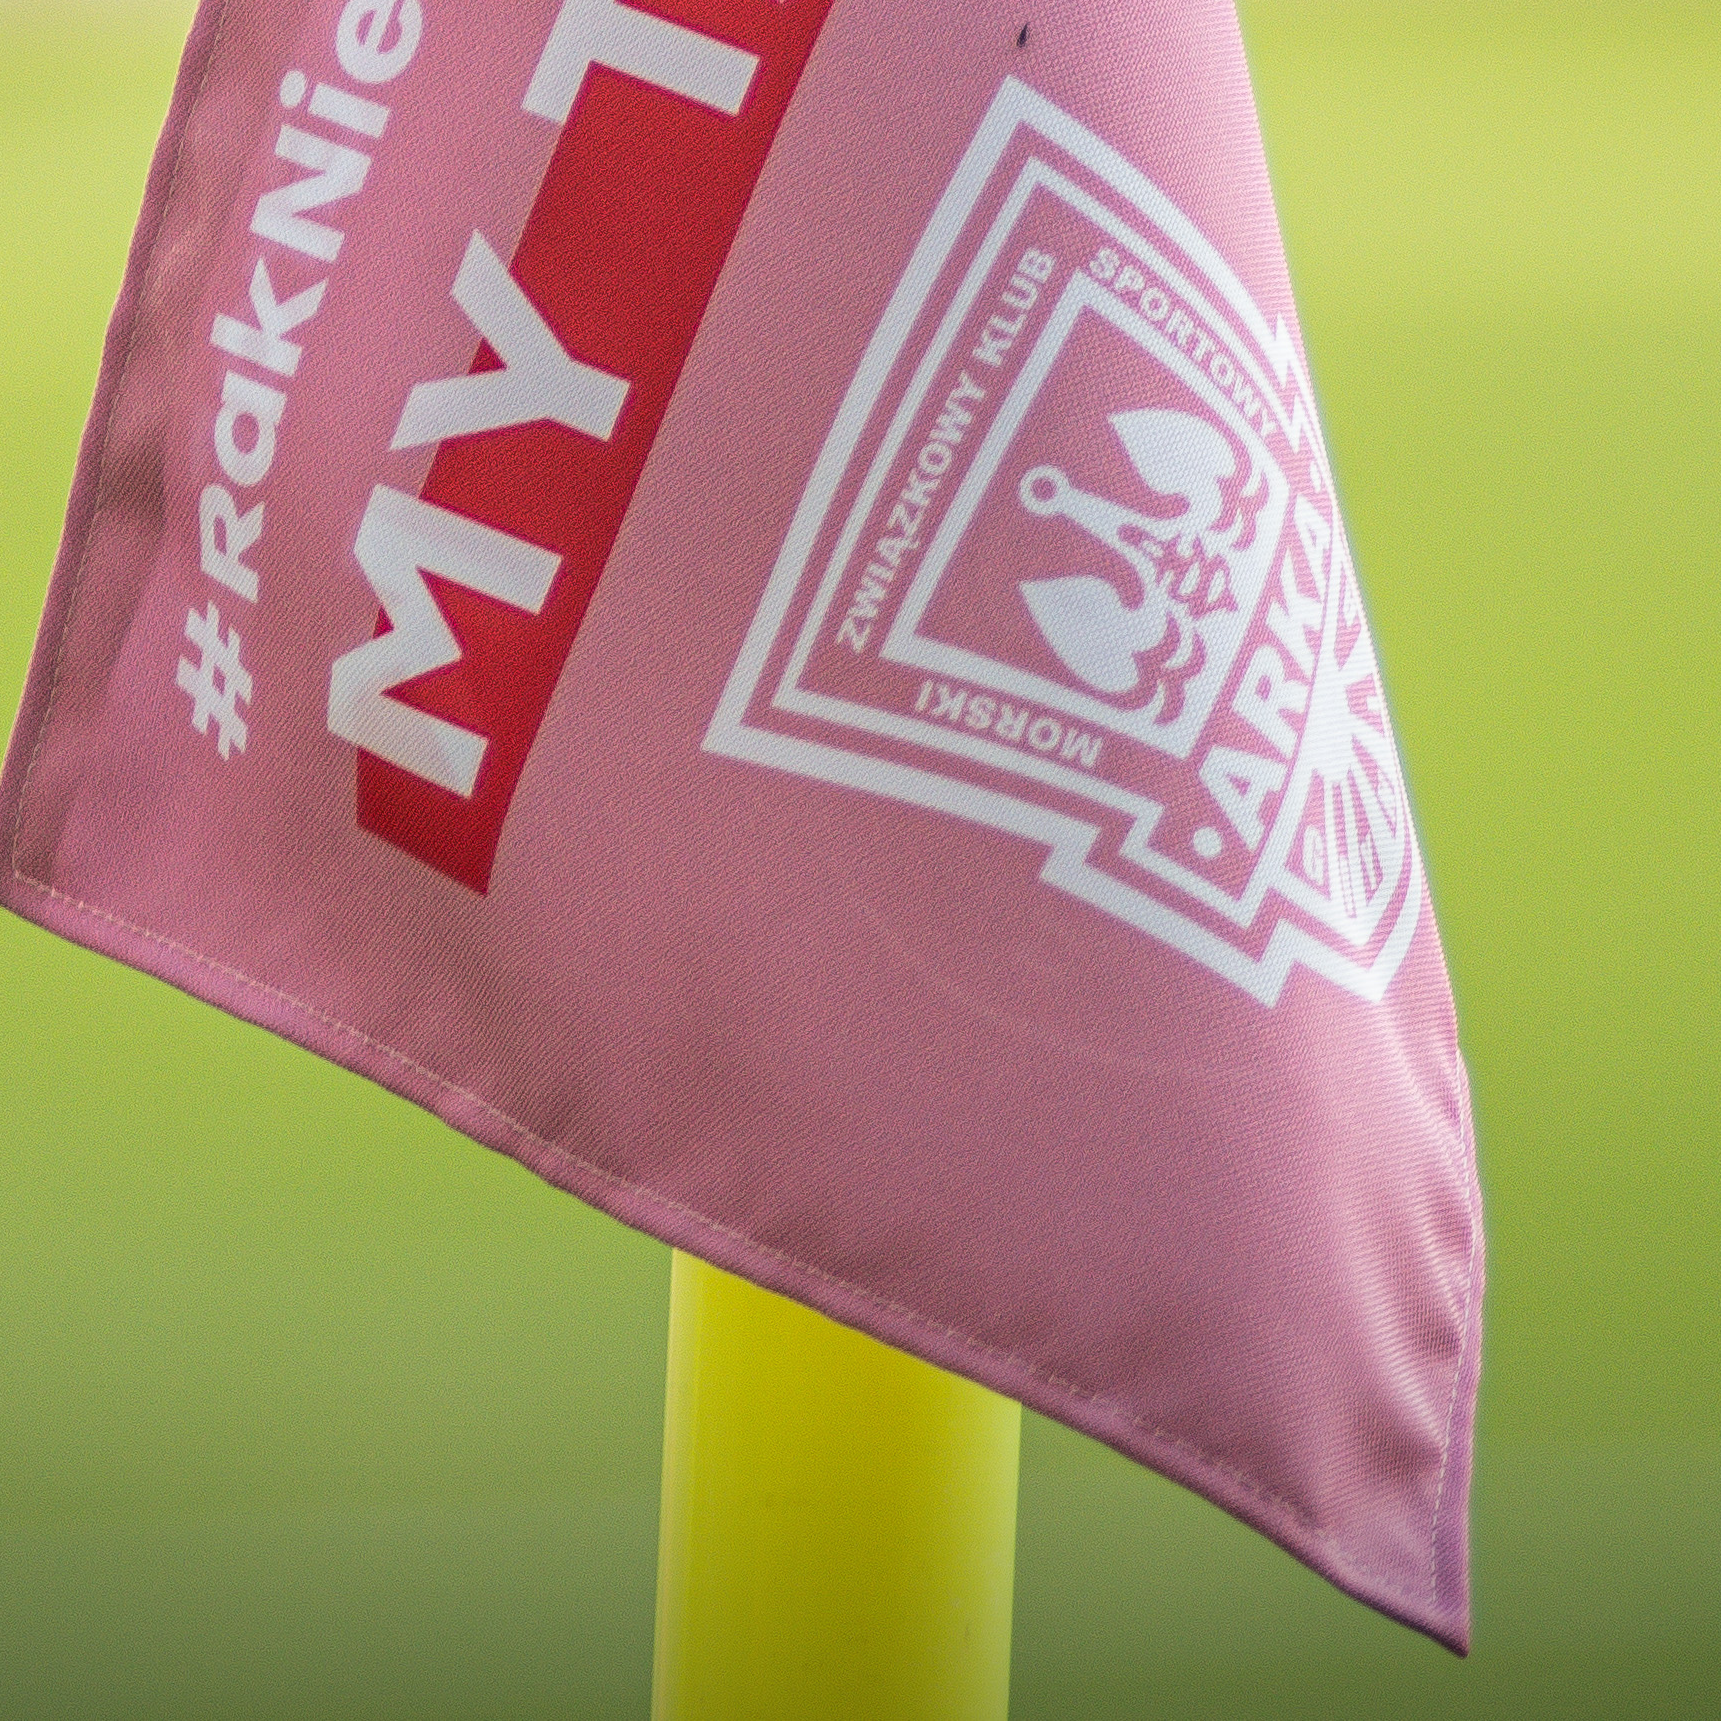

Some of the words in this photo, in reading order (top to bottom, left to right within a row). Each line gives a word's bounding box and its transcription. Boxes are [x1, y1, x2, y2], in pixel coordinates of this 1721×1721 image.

[835, 371, 986, 653] ZWIĄZKOWY
[972, 247, 1057, 373] KLUB
[1087, 247, 1279, 440] SPORTOWY
[327, 229, 632, 799] MY
[913, 679, 1106, 767] MORSKI
